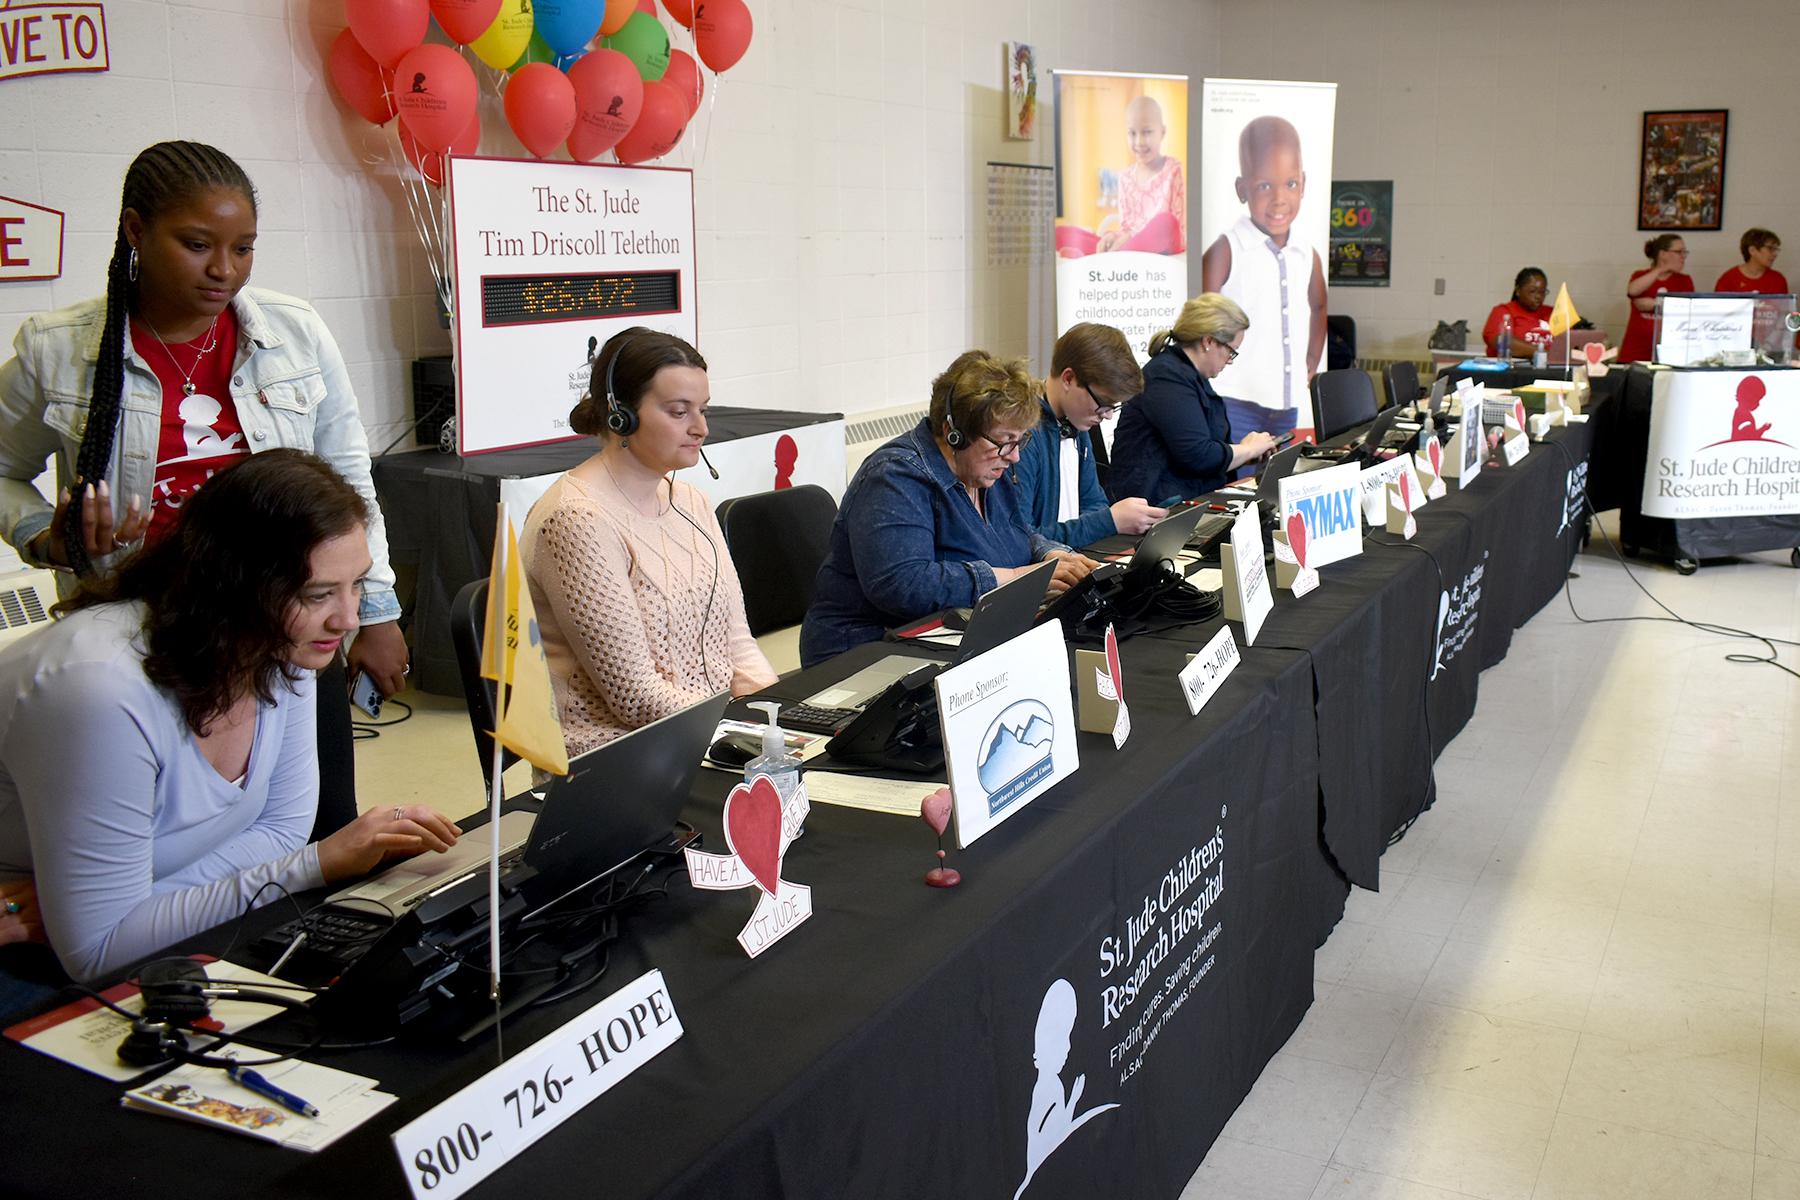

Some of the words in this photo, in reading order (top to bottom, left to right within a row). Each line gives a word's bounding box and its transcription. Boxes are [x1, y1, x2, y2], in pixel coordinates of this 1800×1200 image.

[0, 15, 47, 67] VE
[52, 13, 98, 60] TO
[532, 186, 569, 213] The
[575, 187, 597, 214] St.
[603, 189, 640, 218] Jude
[1331, 207, 1372, 228] 360
[479, 230, 525, 257] Tim
[531, 230, 606, 256] Driscoll
[611, 230, 681, 255] Telethon
[1088, 270, 1104, 282] St.
[1107, 270, 1138, 282] Jude
[1146, 270, 1167, 281] has
[1075, 305, 1133, 319] childhood
[1136, 306, 1176, 317] cancer
[1079, 288, 1118, 303] helped
[1121, 287, 1149, 302] push
[1152, 288, 1172, 299] the
[1660, 457, 1684, 477] St.
[1689, 457, 1728, 480] Jude
[1659, 478, 1738, 498] Research
[949, 692, 974, 711] Phone
[975, 671, 1009, 698] Sponsor:
[782, 803, 800, 839] GIVE
[692, 856, 728, 882] HAVE
[729, 858, 740, 881] A
[772, 894, 801, 934] JUDE
[1100, 936, 1124, 977] St.
[1126, 896, 1157, 967] Jude
[1159, 824, 1224, 913] Children's
[1101, 926, 1169, 1029] Research
[1170, 860, 1224, 950] Hospital
[1165, 955, 1191, 996] Saving
[1191, 922, 1222, 963] children
[1188, 954, 1215, 994] FOUNDER
[414, 1122, 493, 1190] 800-
[503, 1064, 574, 1128] 726-
[577, 988, 672, 1076] HOPE
